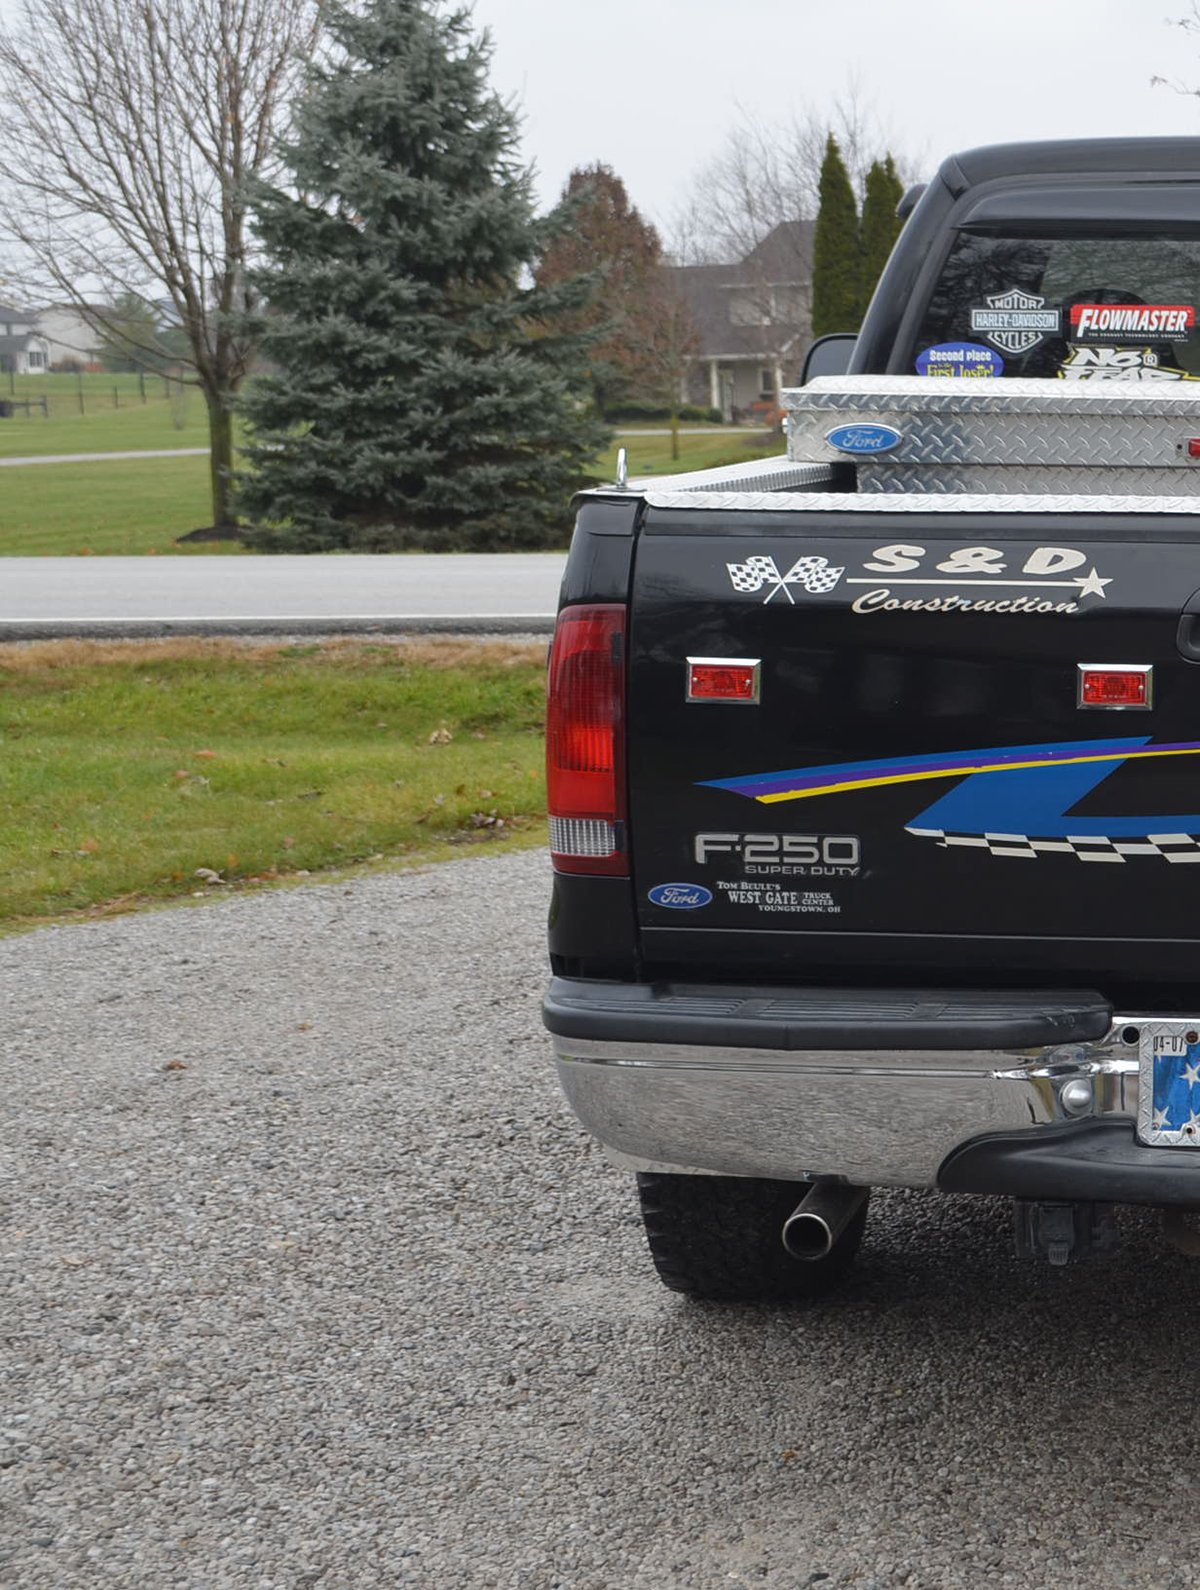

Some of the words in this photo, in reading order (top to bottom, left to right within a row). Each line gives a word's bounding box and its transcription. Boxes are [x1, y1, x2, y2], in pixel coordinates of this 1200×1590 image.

[994, 294, 1038, 310] MOTOR
[975, 313, 1056, 328] HARLEY-DAVIDSON
[1076, 308, 1190, 338] FLOWMASTER
[993, 331, 1037, 349] CYCLES
[929, 349, 965, 361] Second
[842, 429, 885, 448] Ford
[862, 544, 926, 574] S
[935, 546, 1008, 575] &
[1021, 547, 1087, 575] D
[851, 589, 1080, 615] Construction
[744, 865, 805, 875] SUPER
[810, 866, 861, 876] DUTY
[660, 888, 701, 904] Ford
[728, 890, 762, 904] WEST
[765, 891, 799, 905] GATE
[802, 898, 835, 906] CENTER
[827, 905, 841, 913] OH
